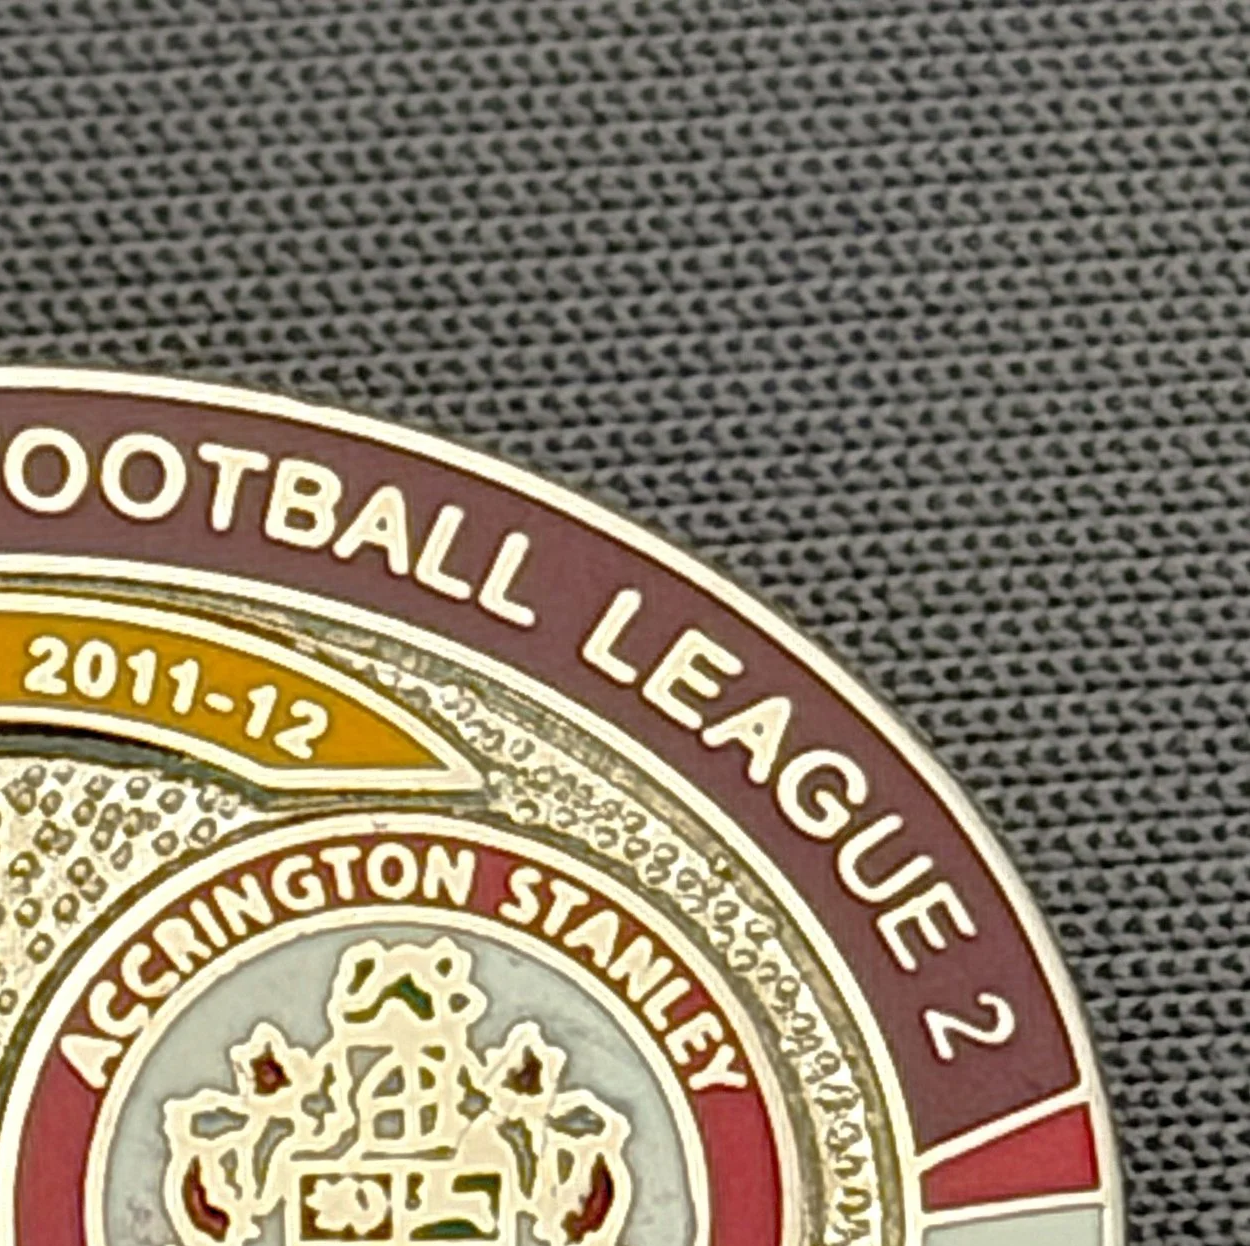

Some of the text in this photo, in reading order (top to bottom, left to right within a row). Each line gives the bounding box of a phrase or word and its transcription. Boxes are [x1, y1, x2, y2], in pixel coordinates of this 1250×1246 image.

[24, 636, 329, 759] 2011-12
[581, 589, 978, 971] LEAGUE
[924, 992, 1015, 1060] 2
[60, 845, 747, 1091] ACCRINGTON STANLEY
